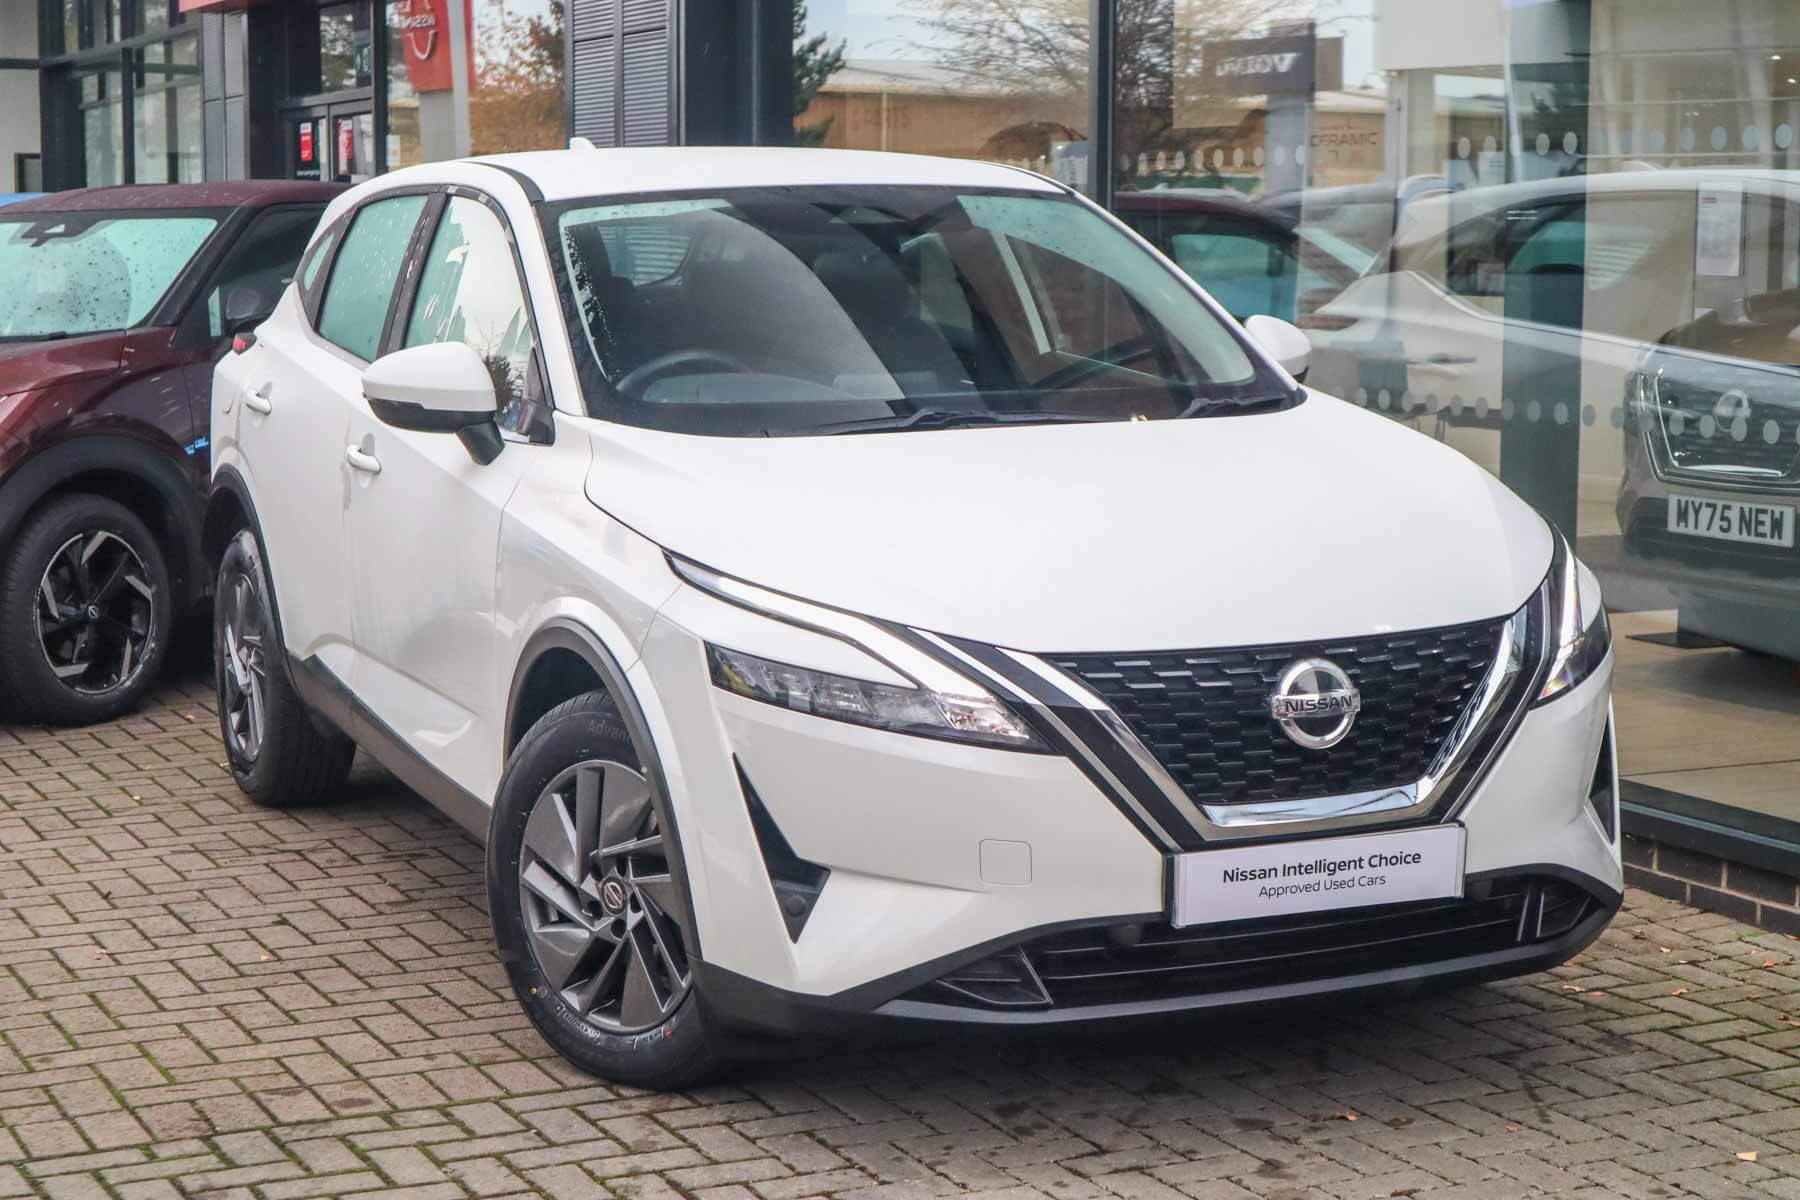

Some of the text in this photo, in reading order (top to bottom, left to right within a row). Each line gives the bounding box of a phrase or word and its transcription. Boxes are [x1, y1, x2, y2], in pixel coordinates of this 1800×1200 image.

[1676, 498, 1784, 540] MY75 NEW
[1285, 695, 1352, 712] NISSAN
[1223, 851, 1421, 883] Nissan Intelligent Choice
[1259, 874, 1386, 899] Approved Used Cars
